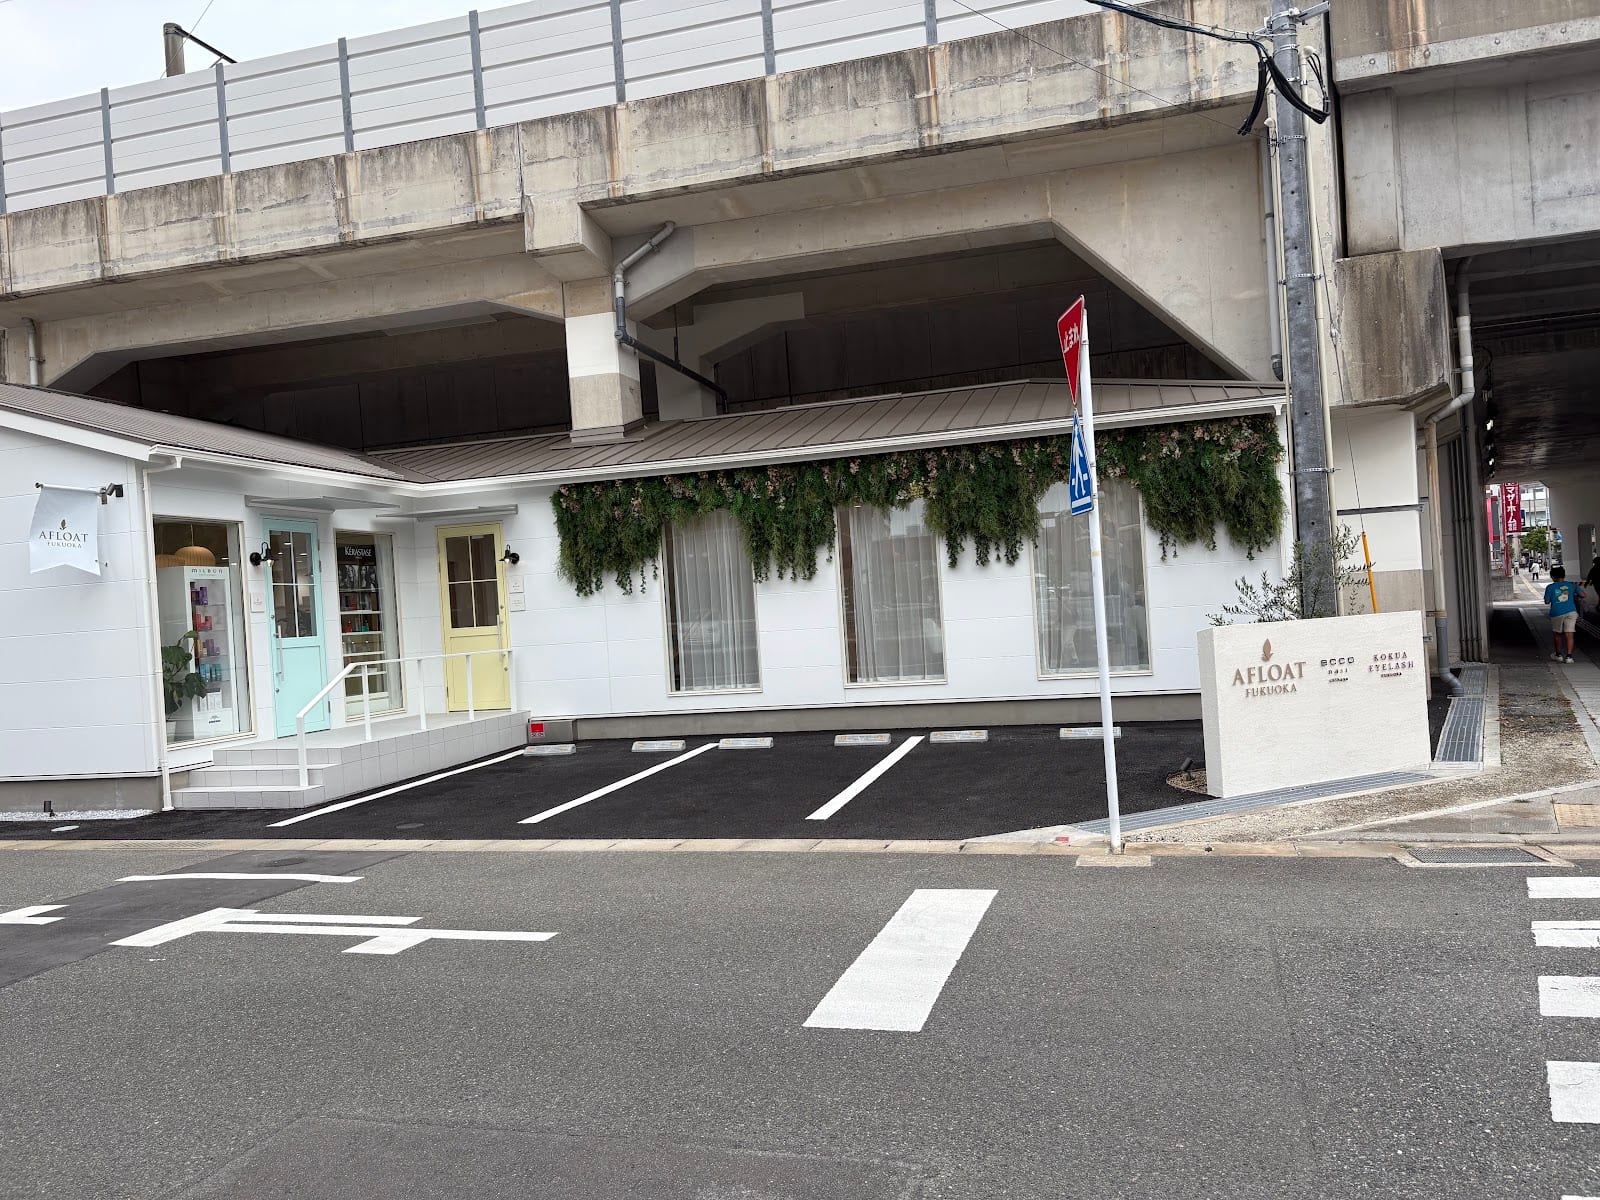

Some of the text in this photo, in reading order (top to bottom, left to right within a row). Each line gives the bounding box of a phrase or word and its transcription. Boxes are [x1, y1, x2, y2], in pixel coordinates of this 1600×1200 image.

[1063, 322, 1080, 354] 止まれ
[39, 530, 89, 543] AFLOAT
[47, 541, 82, 549] FUKUOKA
[1373, 651, 1408, 662] KOKUA
[1367, 660, 1414, 673] EYELASH
[1232, 661, 1307, 687] AFLOAT
[1245, 684, 1298, 698] FUKUOKA
